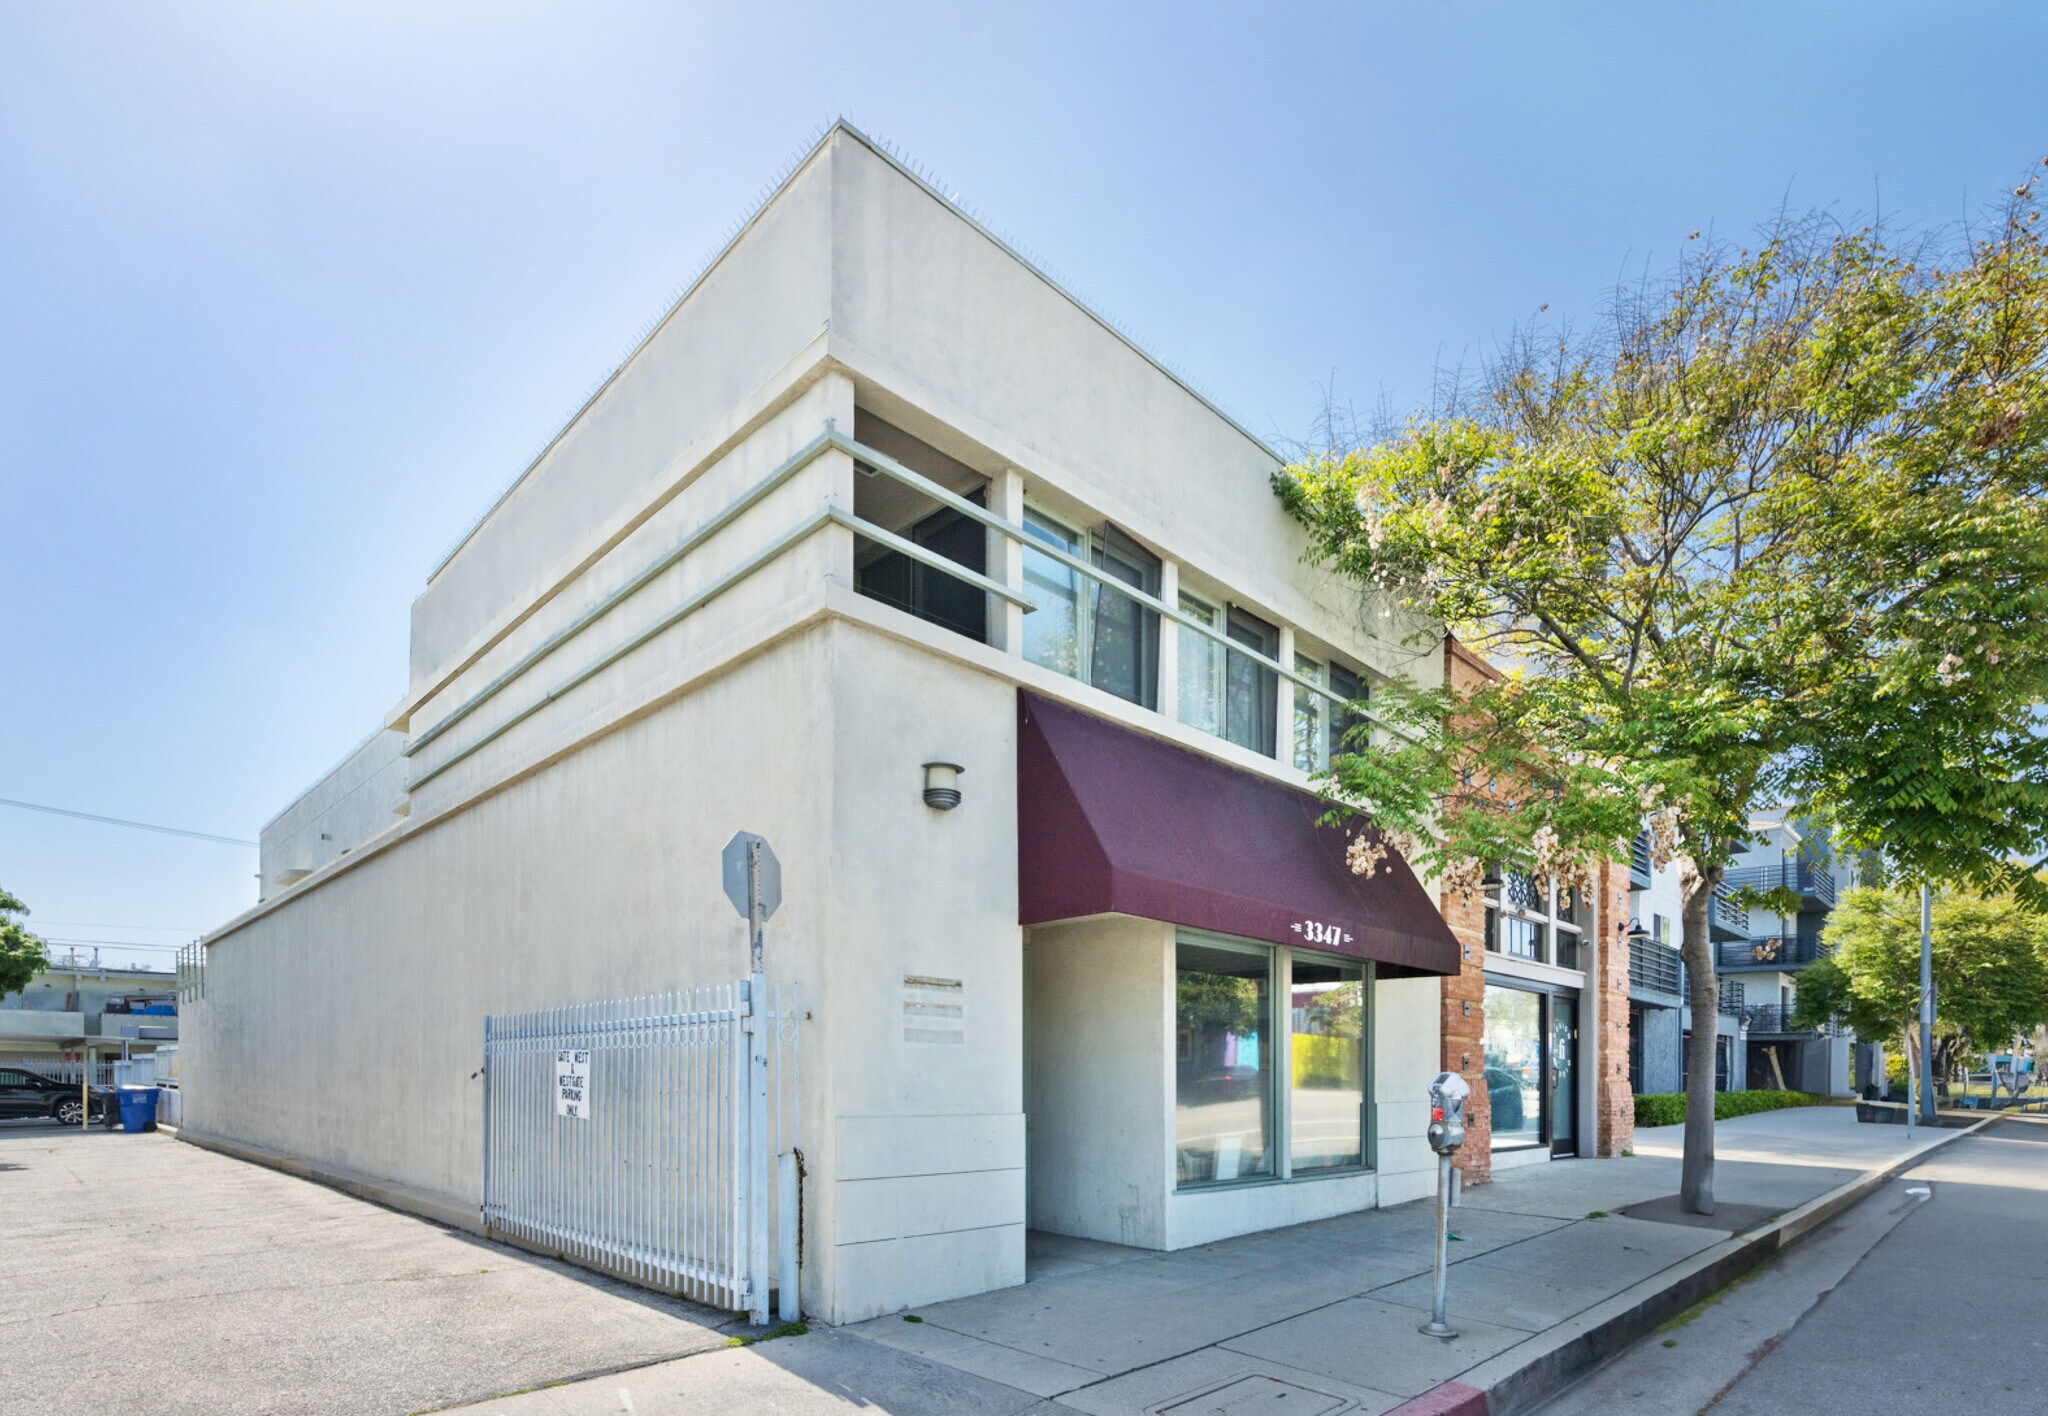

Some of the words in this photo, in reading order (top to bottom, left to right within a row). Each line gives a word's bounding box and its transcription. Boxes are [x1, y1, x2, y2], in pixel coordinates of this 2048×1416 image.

[1304, 920, 1342, 946] 3347
[558, 1051, 570, 1062] GATE
[575, 1051, 589, 1063] WEST
[559, 1075, 584, 1087] WESTGATE
[562, 1088, 582, 1102] PARKING
[566, 1104, 578, 1117] ONLY
